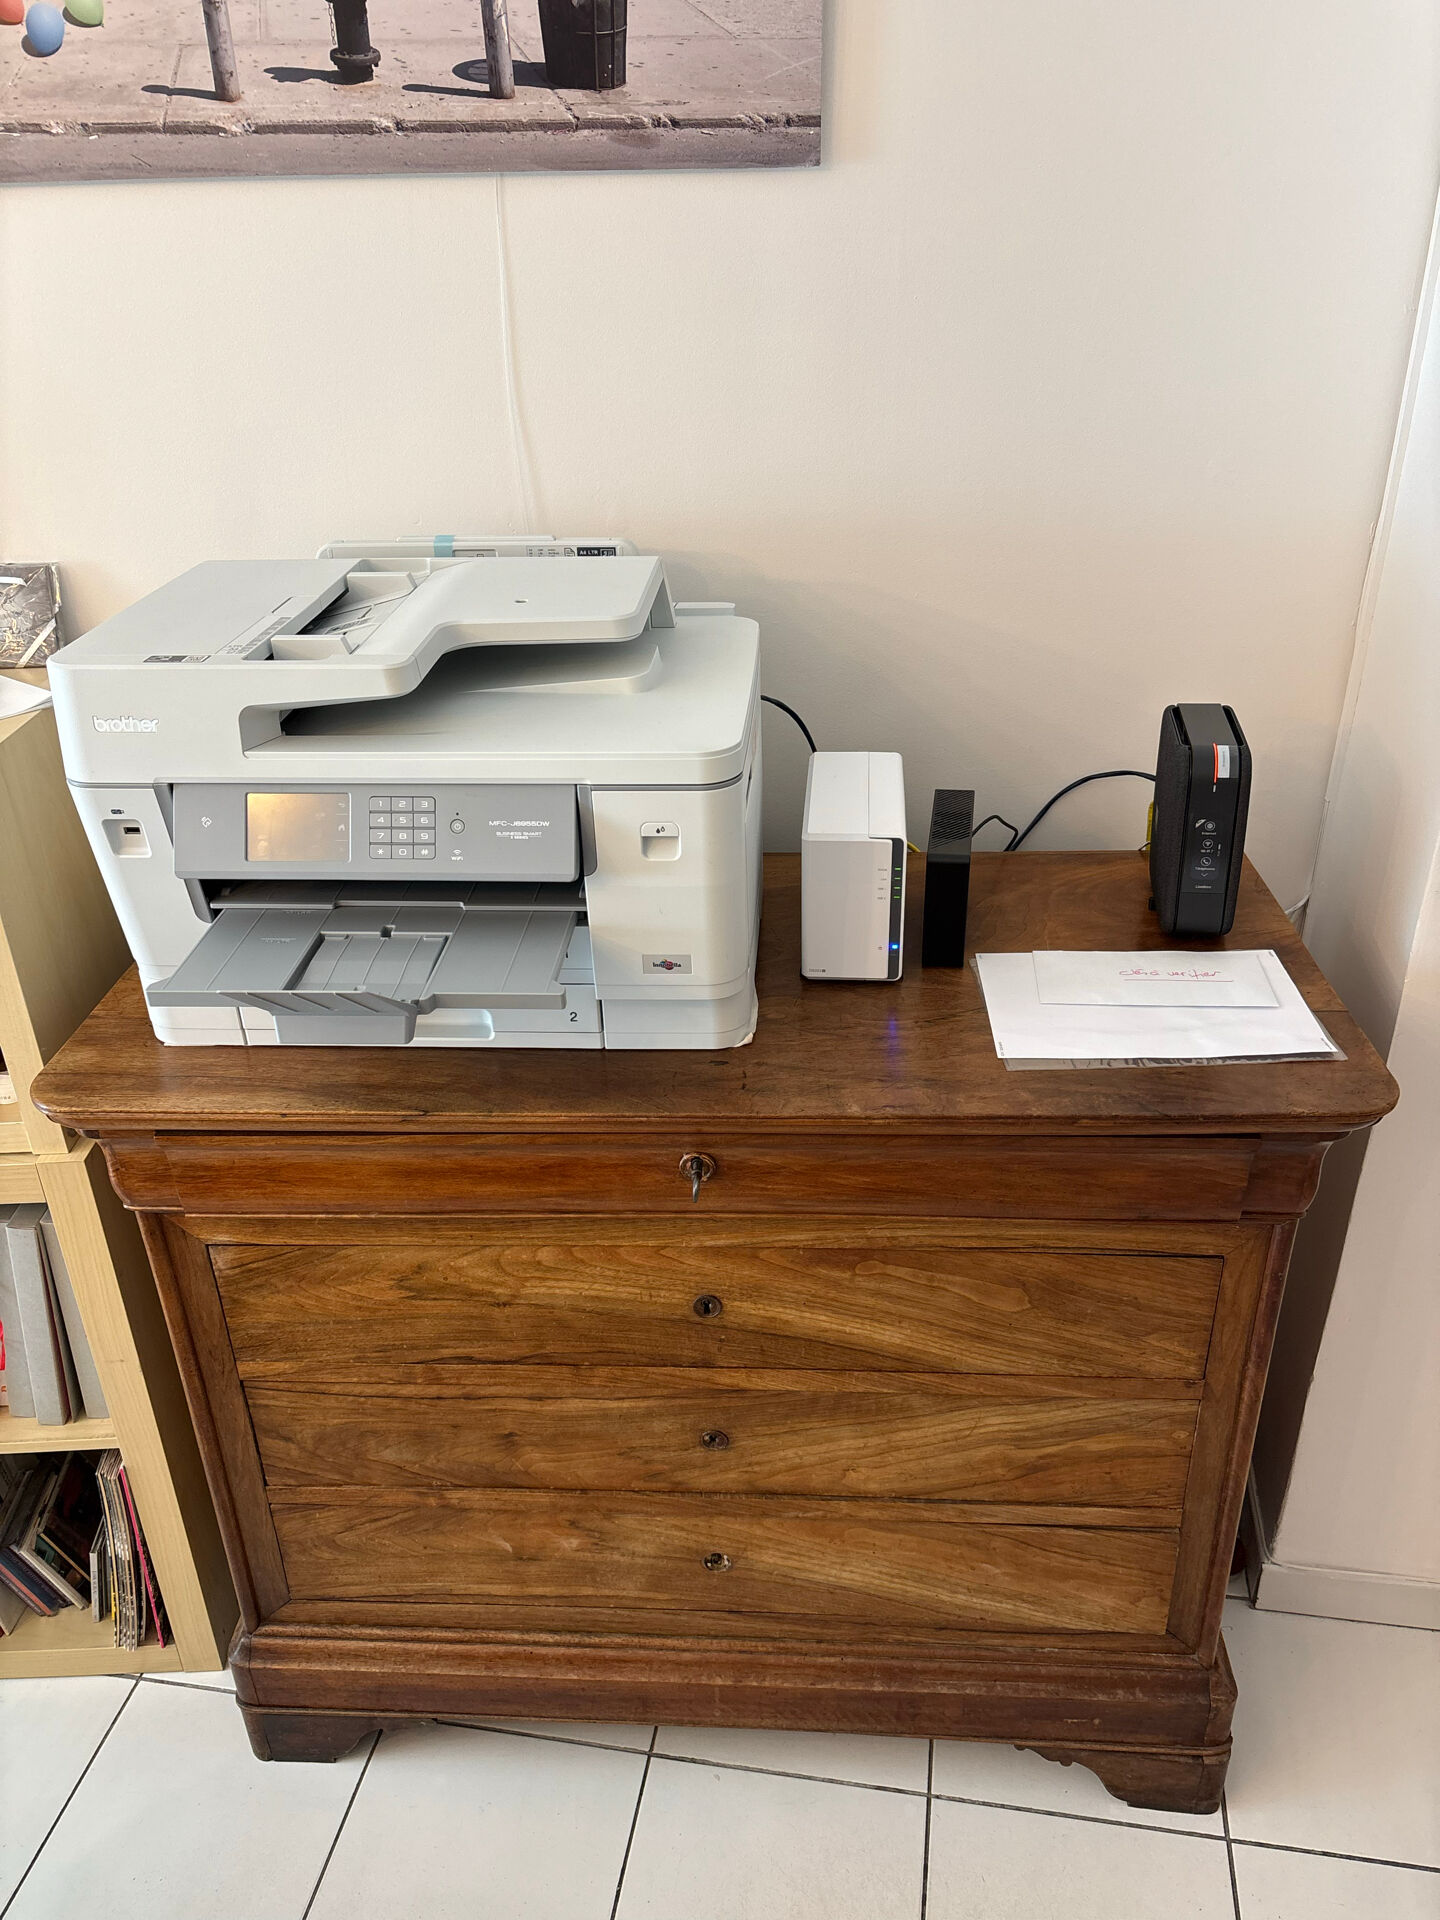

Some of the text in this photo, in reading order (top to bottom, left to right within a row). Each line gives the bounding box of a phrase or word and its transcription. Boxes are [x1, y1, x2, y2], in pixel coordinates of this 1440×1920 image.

[92, 715, 159, 733] brother
[398, 800, 406, 808] 2
[421, 800, 428, 808] 3
[399, 816, 407, 824] 5
[420, 816, 429, 824] 6
[420, 832, 429, 840] 9
[398, 848, 407, 856] 0
[569, 1011, 578, 1022] 2
